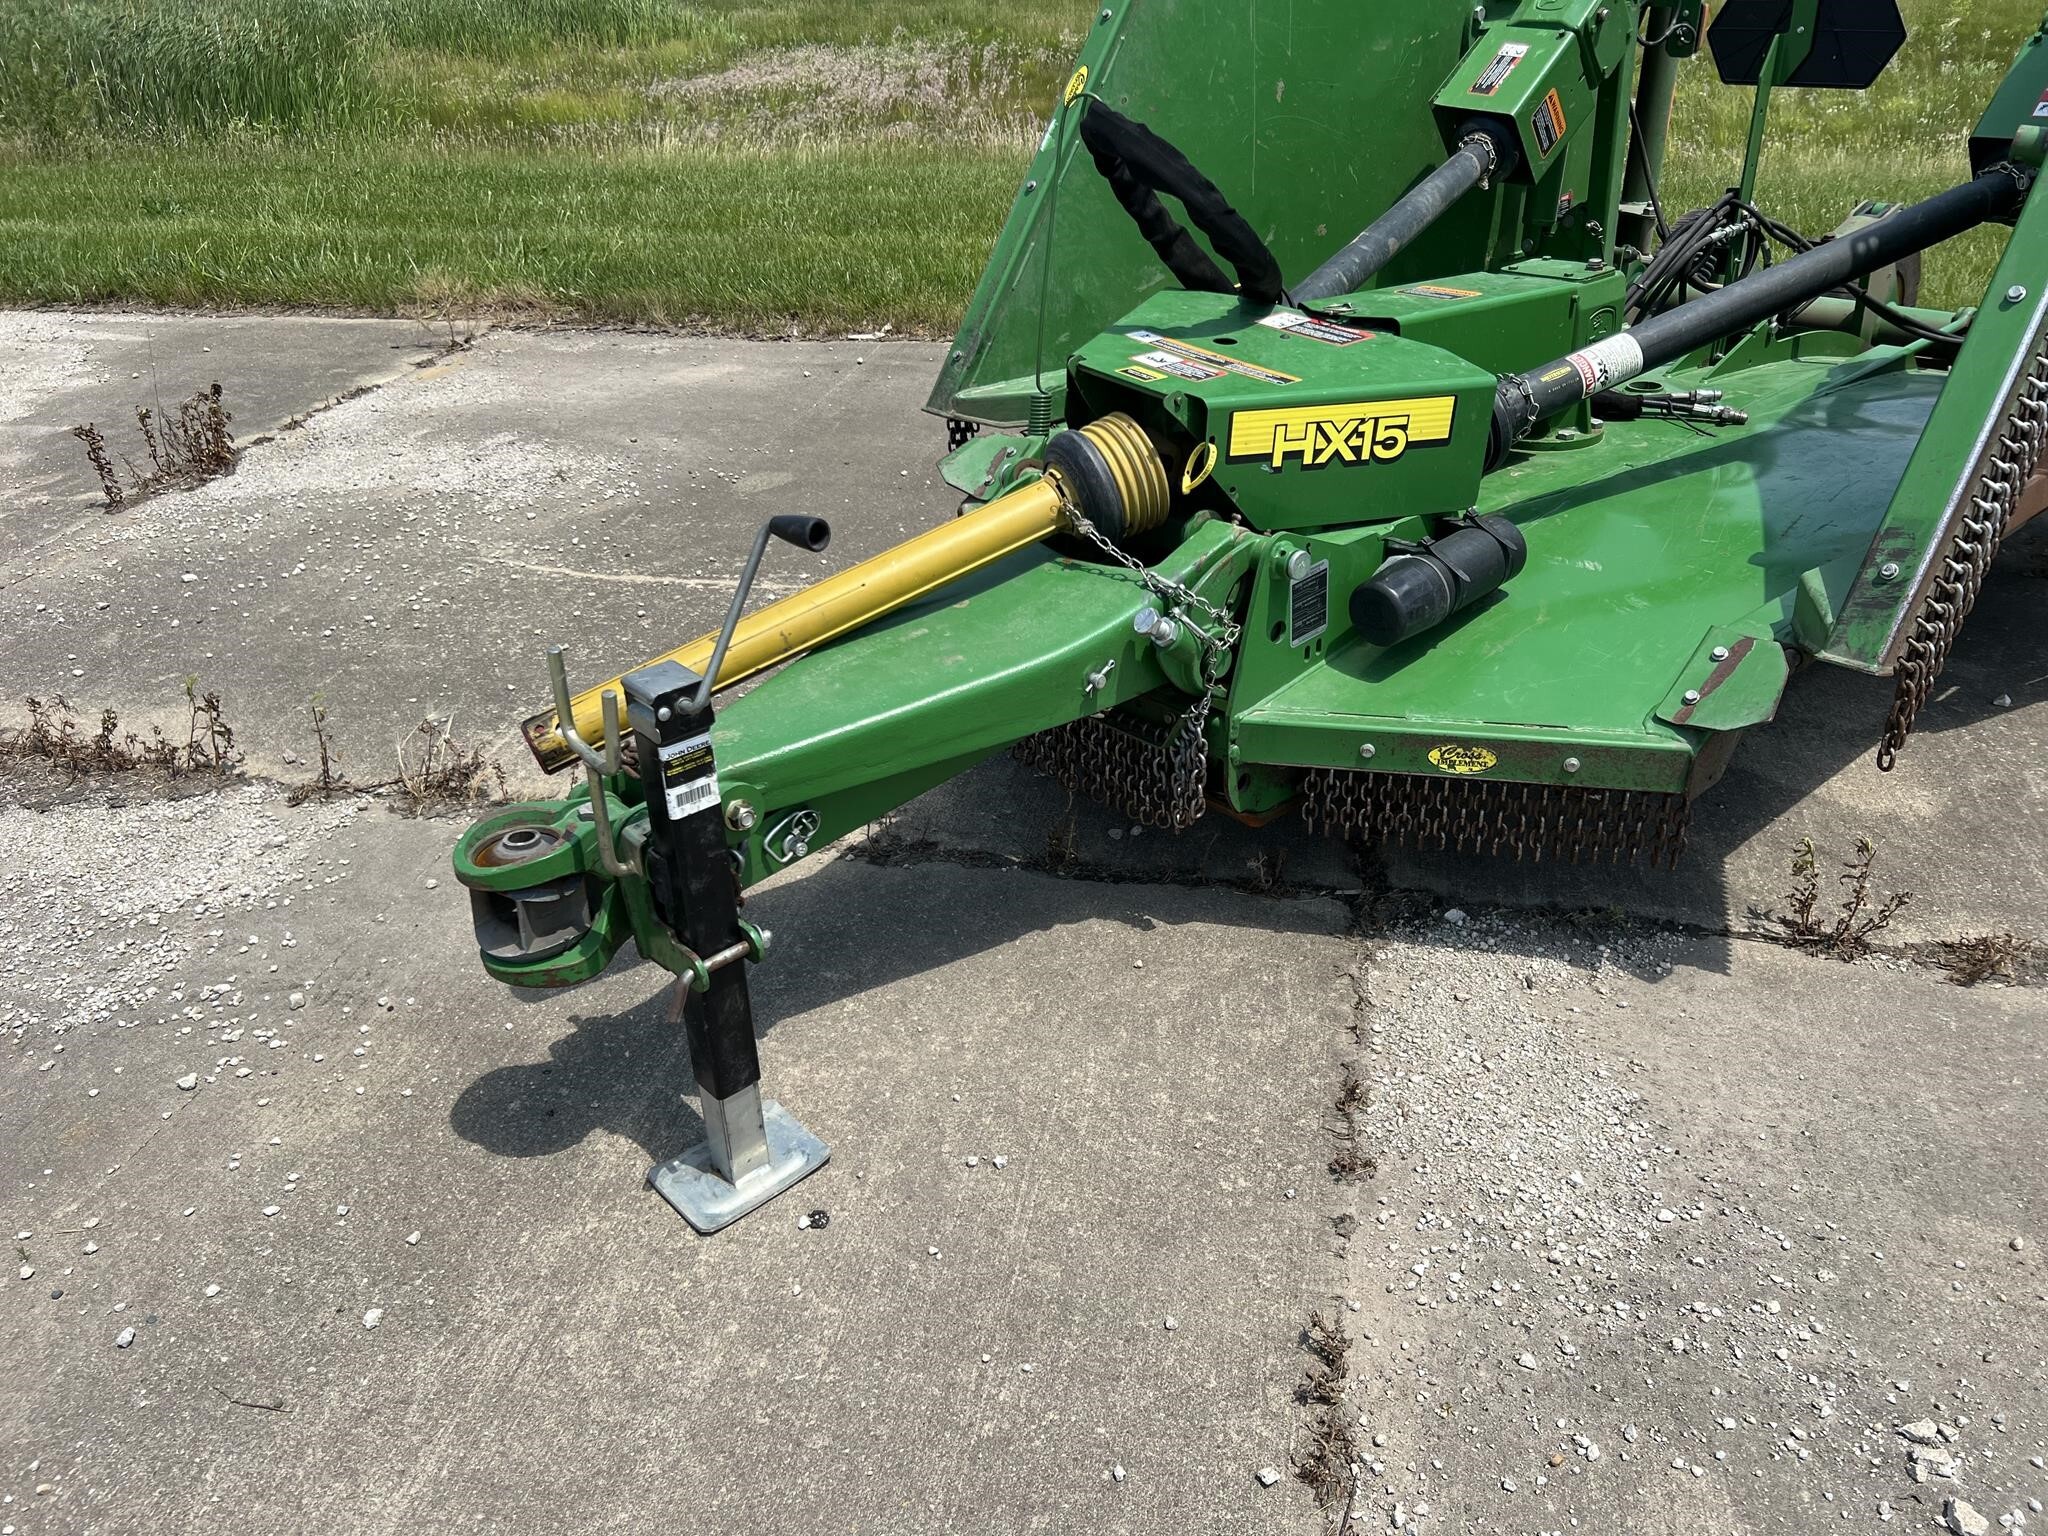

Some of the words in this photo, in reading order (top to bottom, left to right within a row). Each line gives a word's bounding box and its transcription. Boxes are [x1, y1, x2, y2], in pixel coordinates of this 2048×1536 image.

[666, 749, 686, 760] JOHN
[686, 740, 711, 753] DEERE
[1440, 746, 1483, 760] Cross
